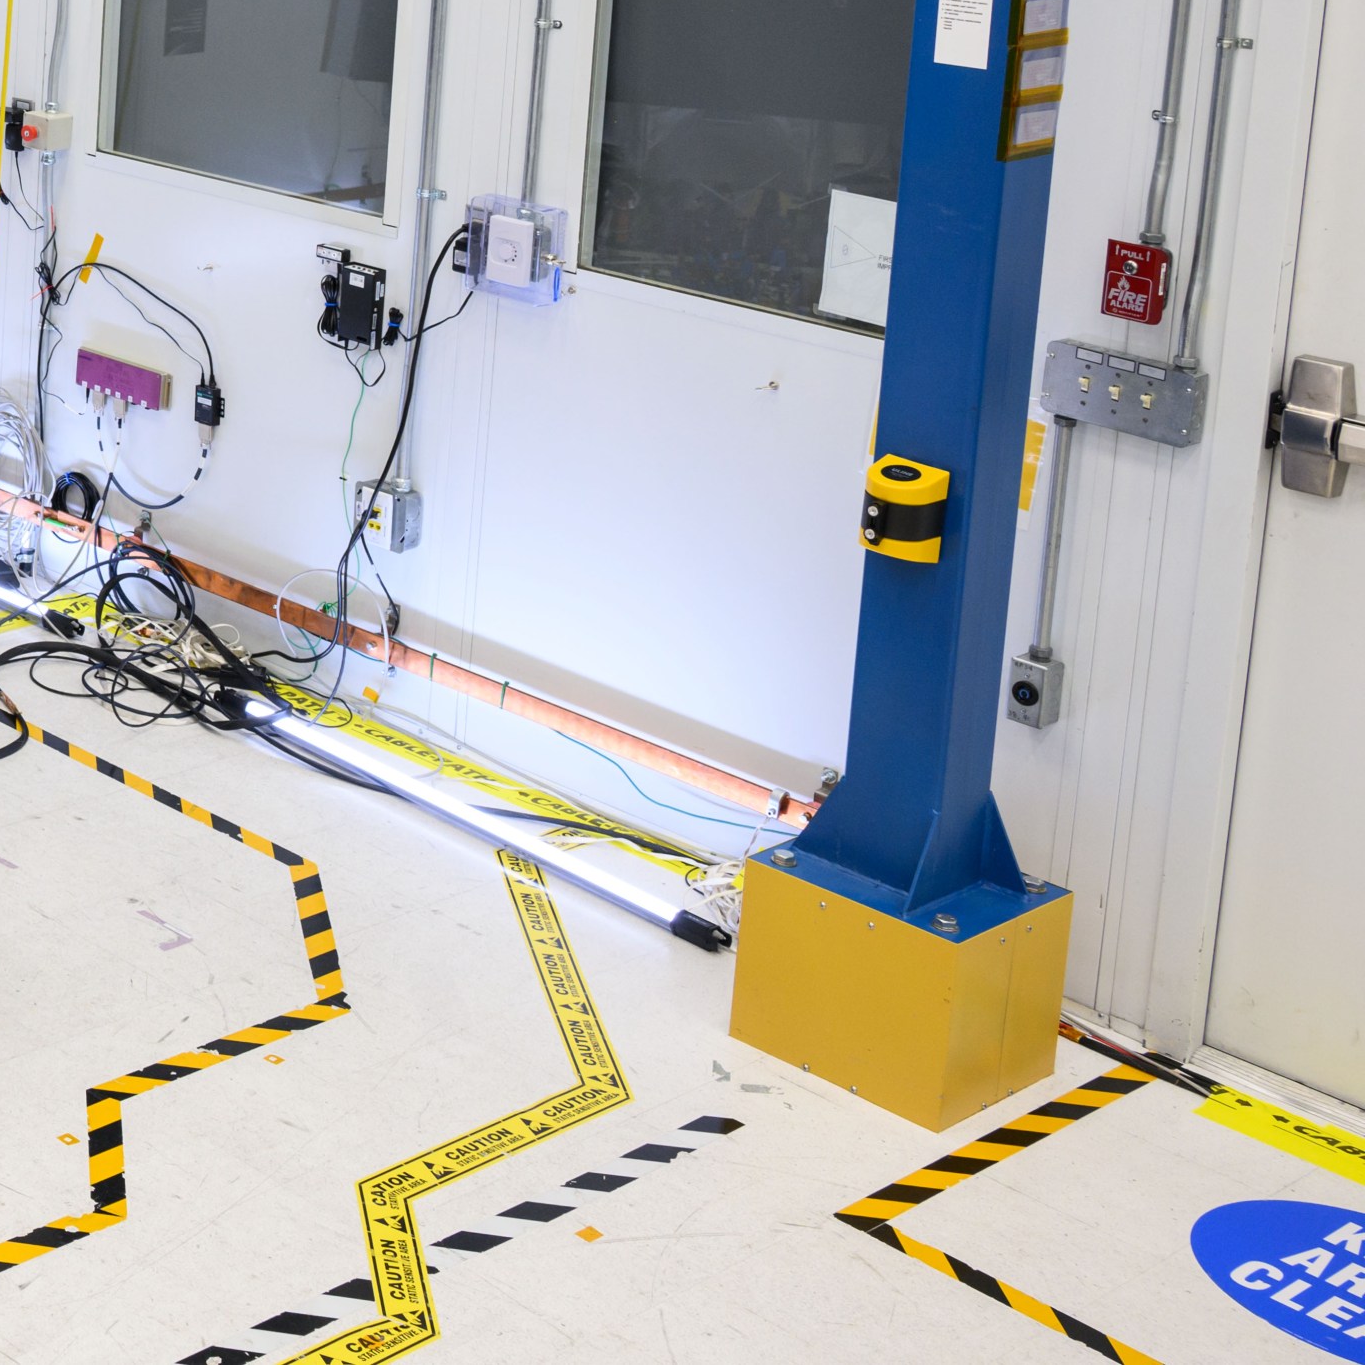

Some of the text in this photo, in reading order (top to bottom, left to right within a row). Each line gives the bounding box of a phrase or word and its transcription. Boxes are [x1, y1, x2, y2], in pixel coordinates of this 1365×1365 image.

[1120, 249, 1144, 261] PULL
[1108, 287, 1148, 306] FIRE
[1110, 299, 1144, 313] ALARM
[507, 853, 523, 873] CAU
[520, 892, 545, 932] CAUTION
[542, 953, 569, 996] CAUTION
[568, 1019, 597, 1066] CAUTION
[542, 1086, 607, 1118] CAUTION
[444, 1127, 514, 1161] CAUTION
[1292, 1124, 1365, 1161] CAB
[409, 1178, 427, 1190] AREA
[397, 1239, 408, 1254] AREA
[379, 1239, 406, 1300] CAUTION
[1278, 1246, 1365, 1299] AR
[408, 1283, 419, 1304] STATIC
[357, 1330, 420, 1362] STATIC SENSITIVE
